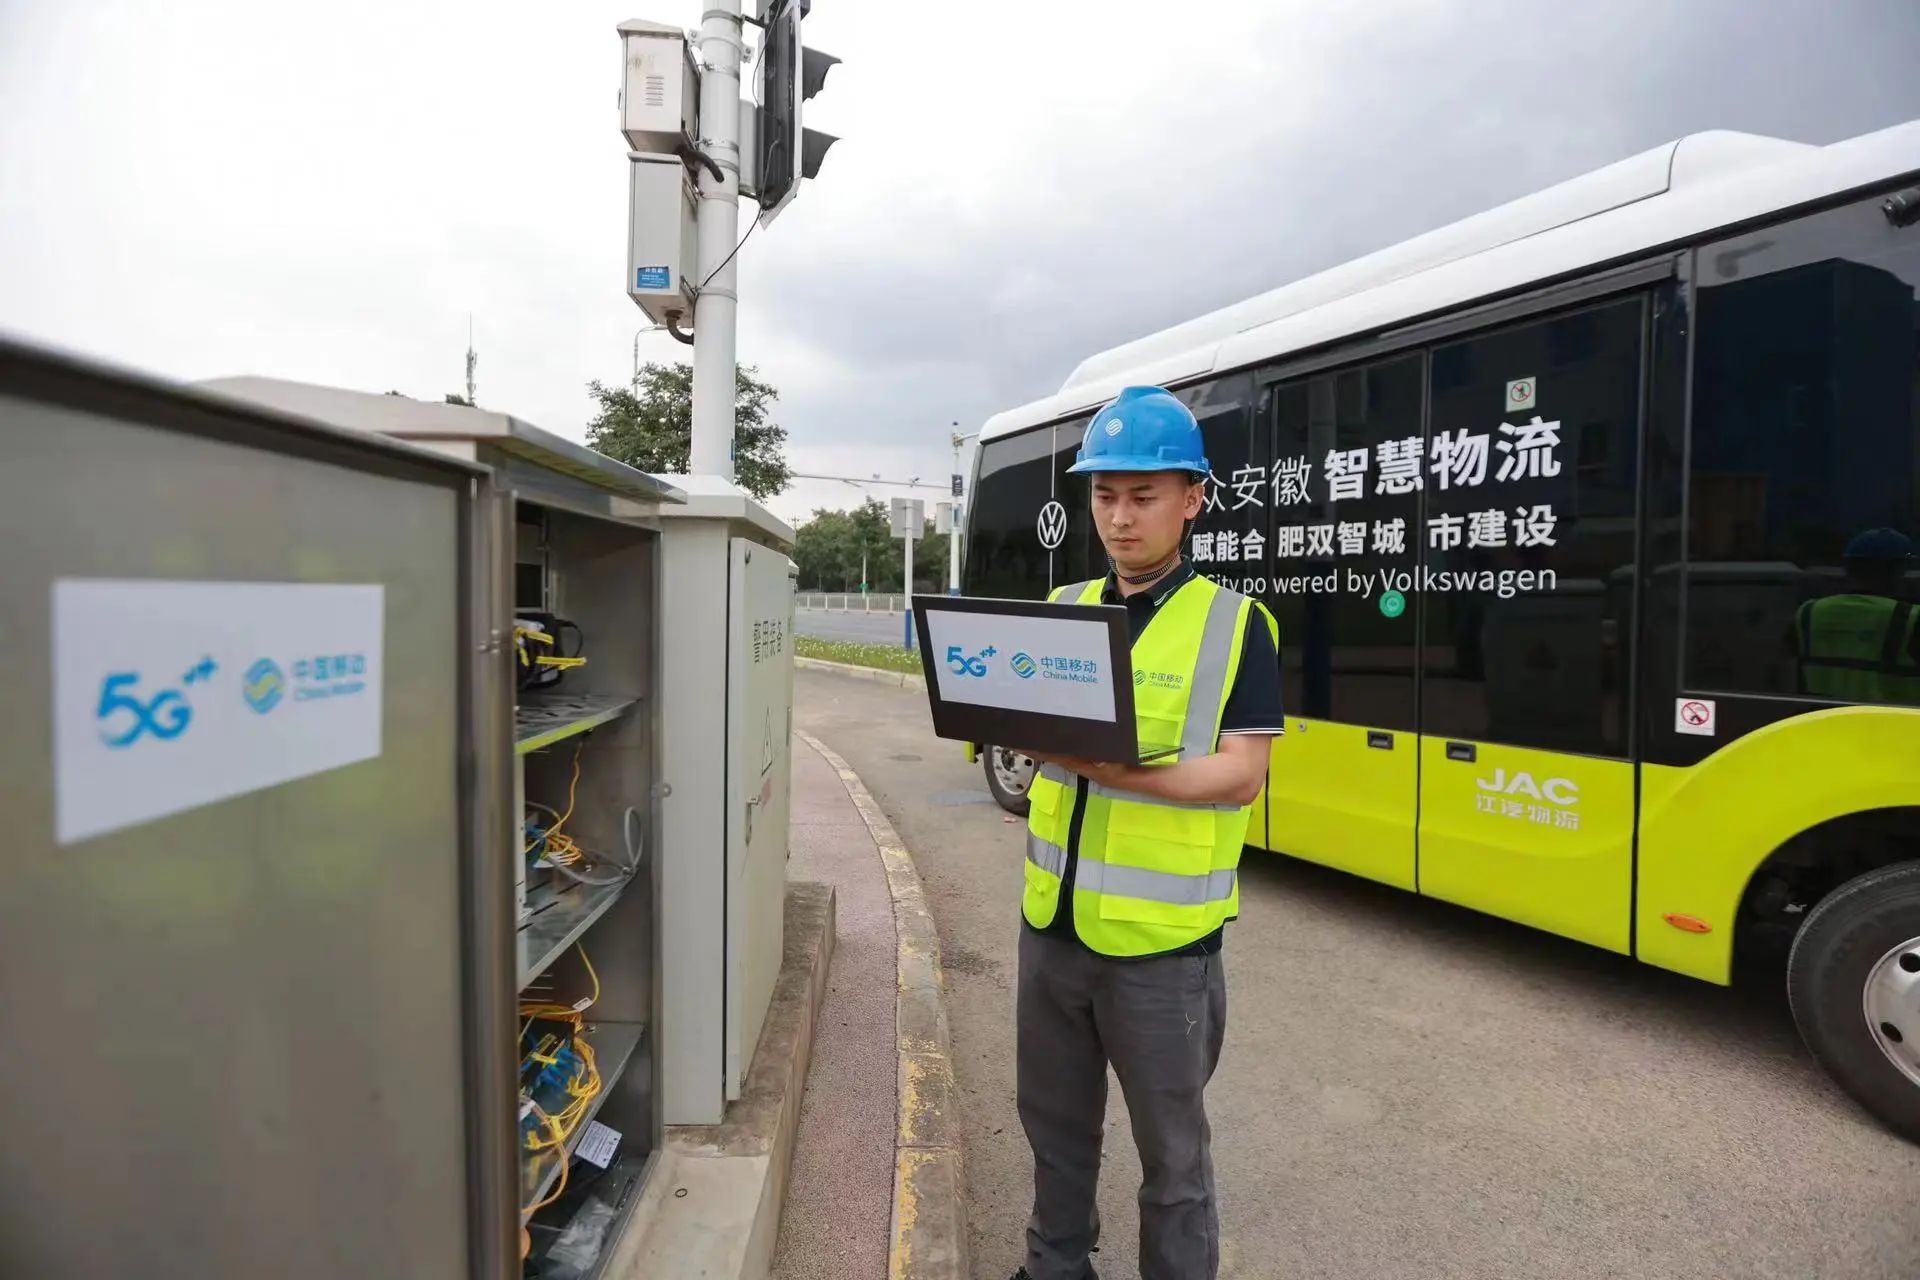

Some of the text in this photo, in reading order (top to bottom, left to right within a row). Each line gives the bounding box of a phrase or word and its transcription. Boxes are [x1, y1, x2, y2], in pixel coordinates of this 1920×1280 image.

[1323, 416, 1562, 502] 智慧物流
[1347, 568, 1376, 599] by
[1380, 565, 1557, 599] Volkswagen
[1040, 656, 1097, 673] 中国移动
[1043, 670, 1098, 684] China Mobile
[1150, 672, 1184, 684] 中国移动
[1476, 768, 1579, 805] JAC
